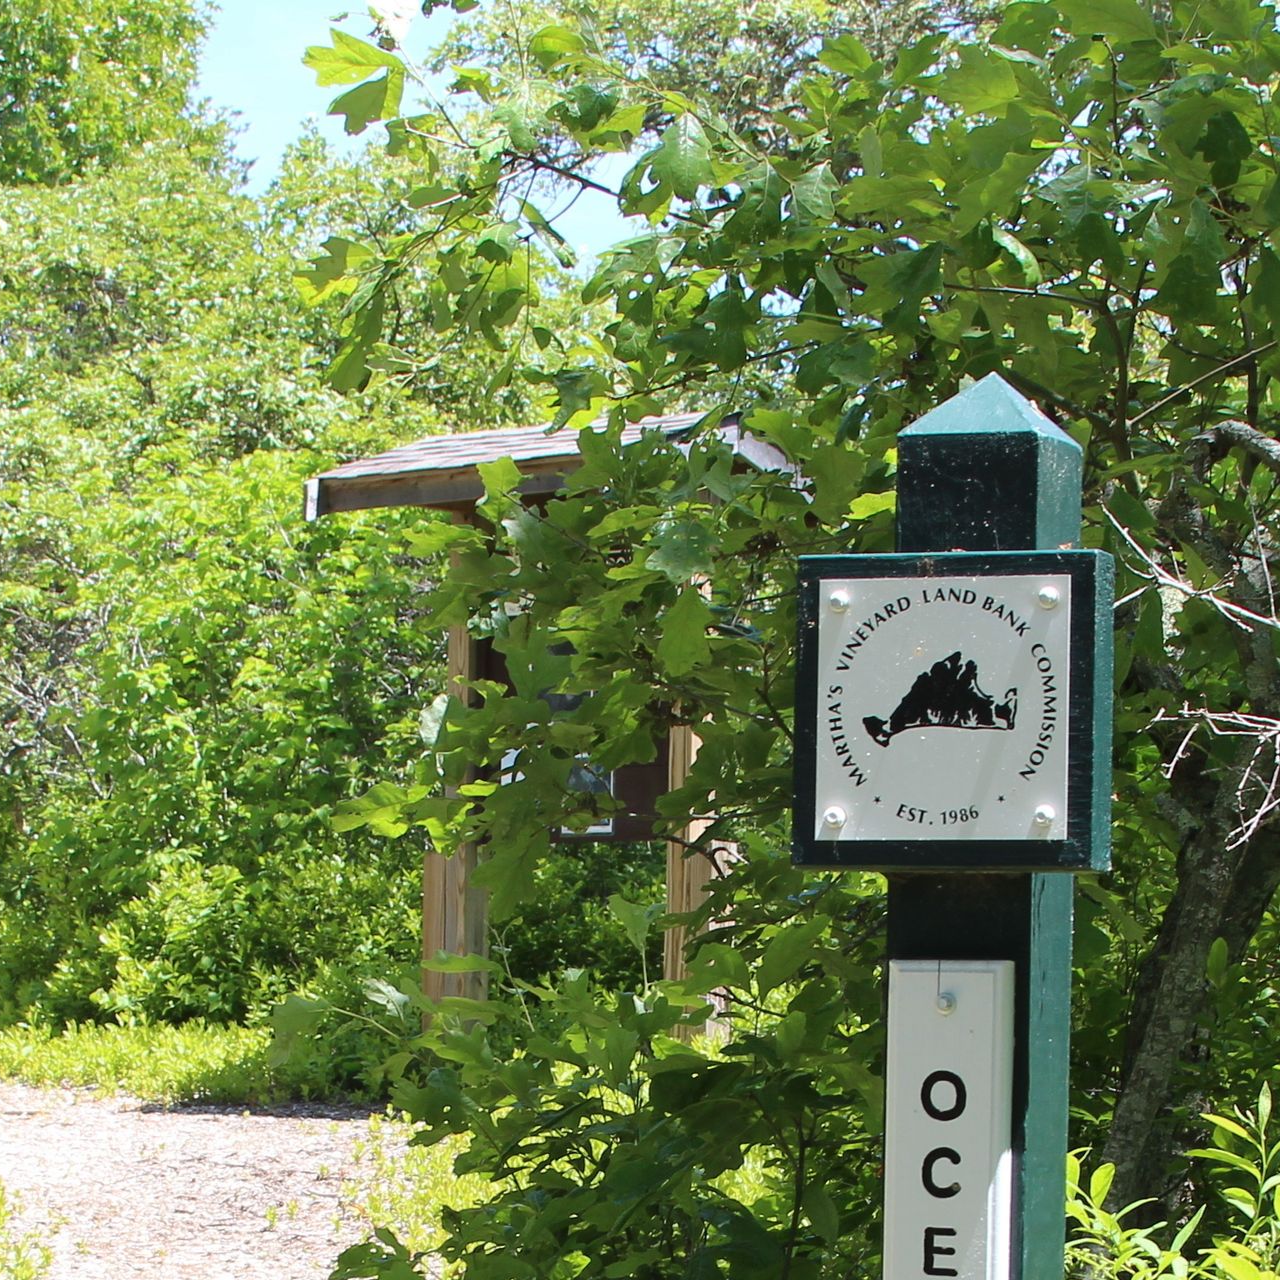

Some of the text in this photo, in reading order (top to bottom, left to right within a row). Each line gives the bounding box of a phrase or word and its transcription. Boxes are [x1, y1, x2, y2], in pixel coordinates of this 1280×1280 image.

[827, 587, 1057, 787] MARTHA'S VINEYARD LAND BANK COMMISSION
[896, 803, 980, 826] EST. 1986
